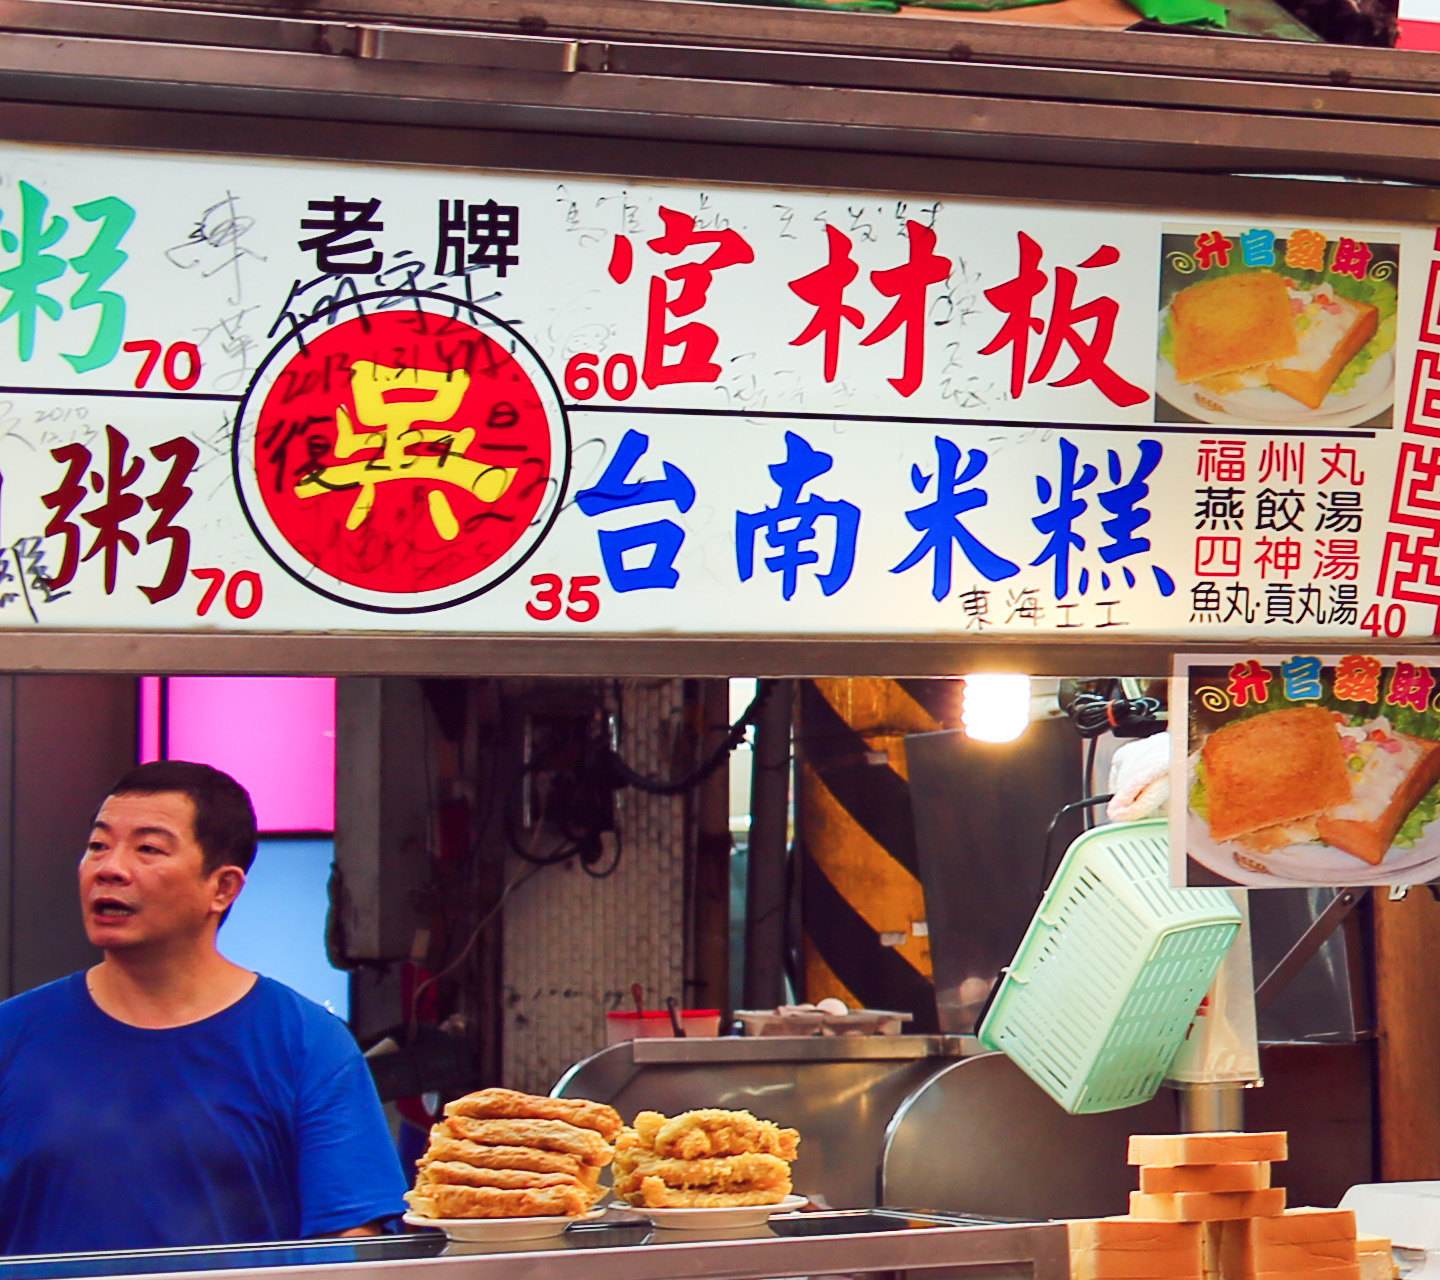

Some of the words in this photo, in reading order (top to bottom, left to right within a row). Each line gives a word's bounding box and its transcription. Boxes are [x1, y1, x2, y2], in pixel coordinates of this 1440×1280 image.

[298, 195, 521, 278] 老牌
[1194, 229, 1374, 280] 升官發財
[608, 206, 1150, 409] 官材板
[123, 339, 201, 391] 70
[565, 353, 637, 401] 60
[1197, 439, 1366, 488] 福州丸
[41, 424, 201, 605] 粥
[577, 429, 1176, 603] 台南米糕
[1194, 487, 1364, 534] 燕餃湯
[1195, 535, 1361, 582] 四神湯
[191, 567, 264, 620] 70
[526, 573, 601, 623] 35
[1360, 603, 1407, 639] 40
[1228, 656, 1438, 712] 升官發財
